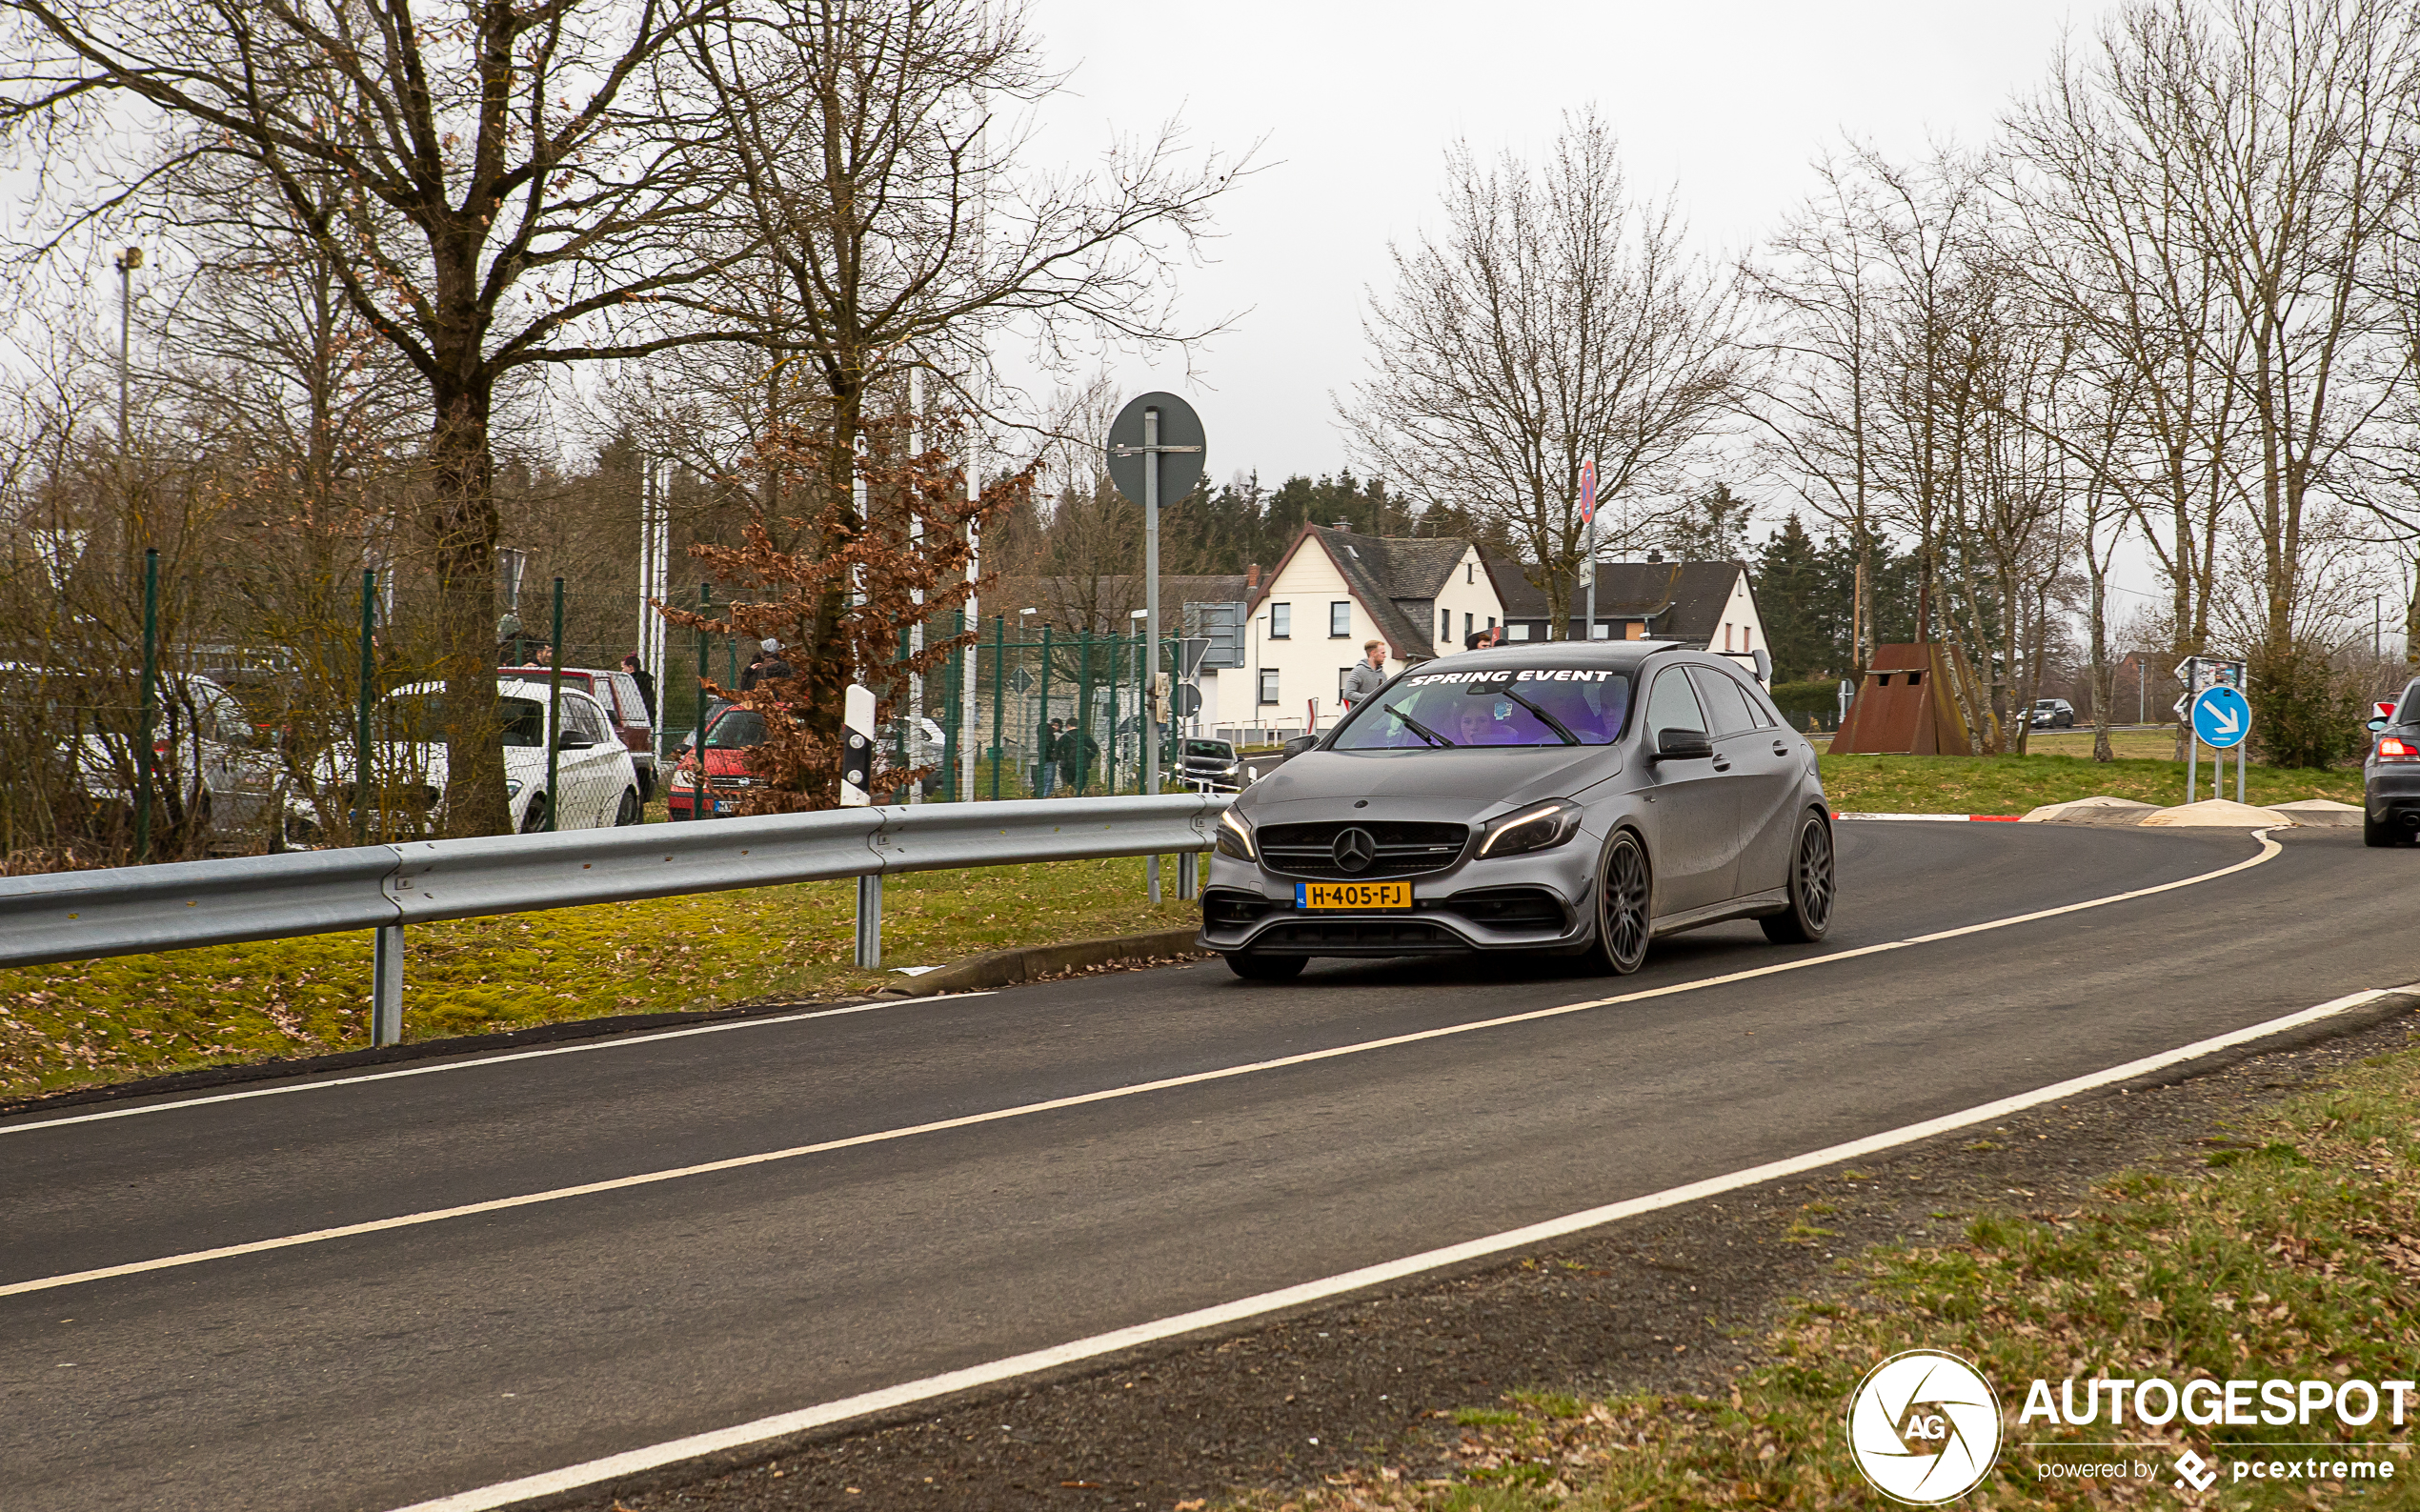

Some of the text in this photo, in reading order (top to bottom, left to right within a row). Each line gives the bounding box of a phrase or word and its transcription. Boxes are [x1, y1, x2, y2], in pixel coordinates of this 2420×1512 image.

[1407, 670, 1613, 687] SPRING EVENT
[1312, 886, 1401, 905] H-405-FJ
